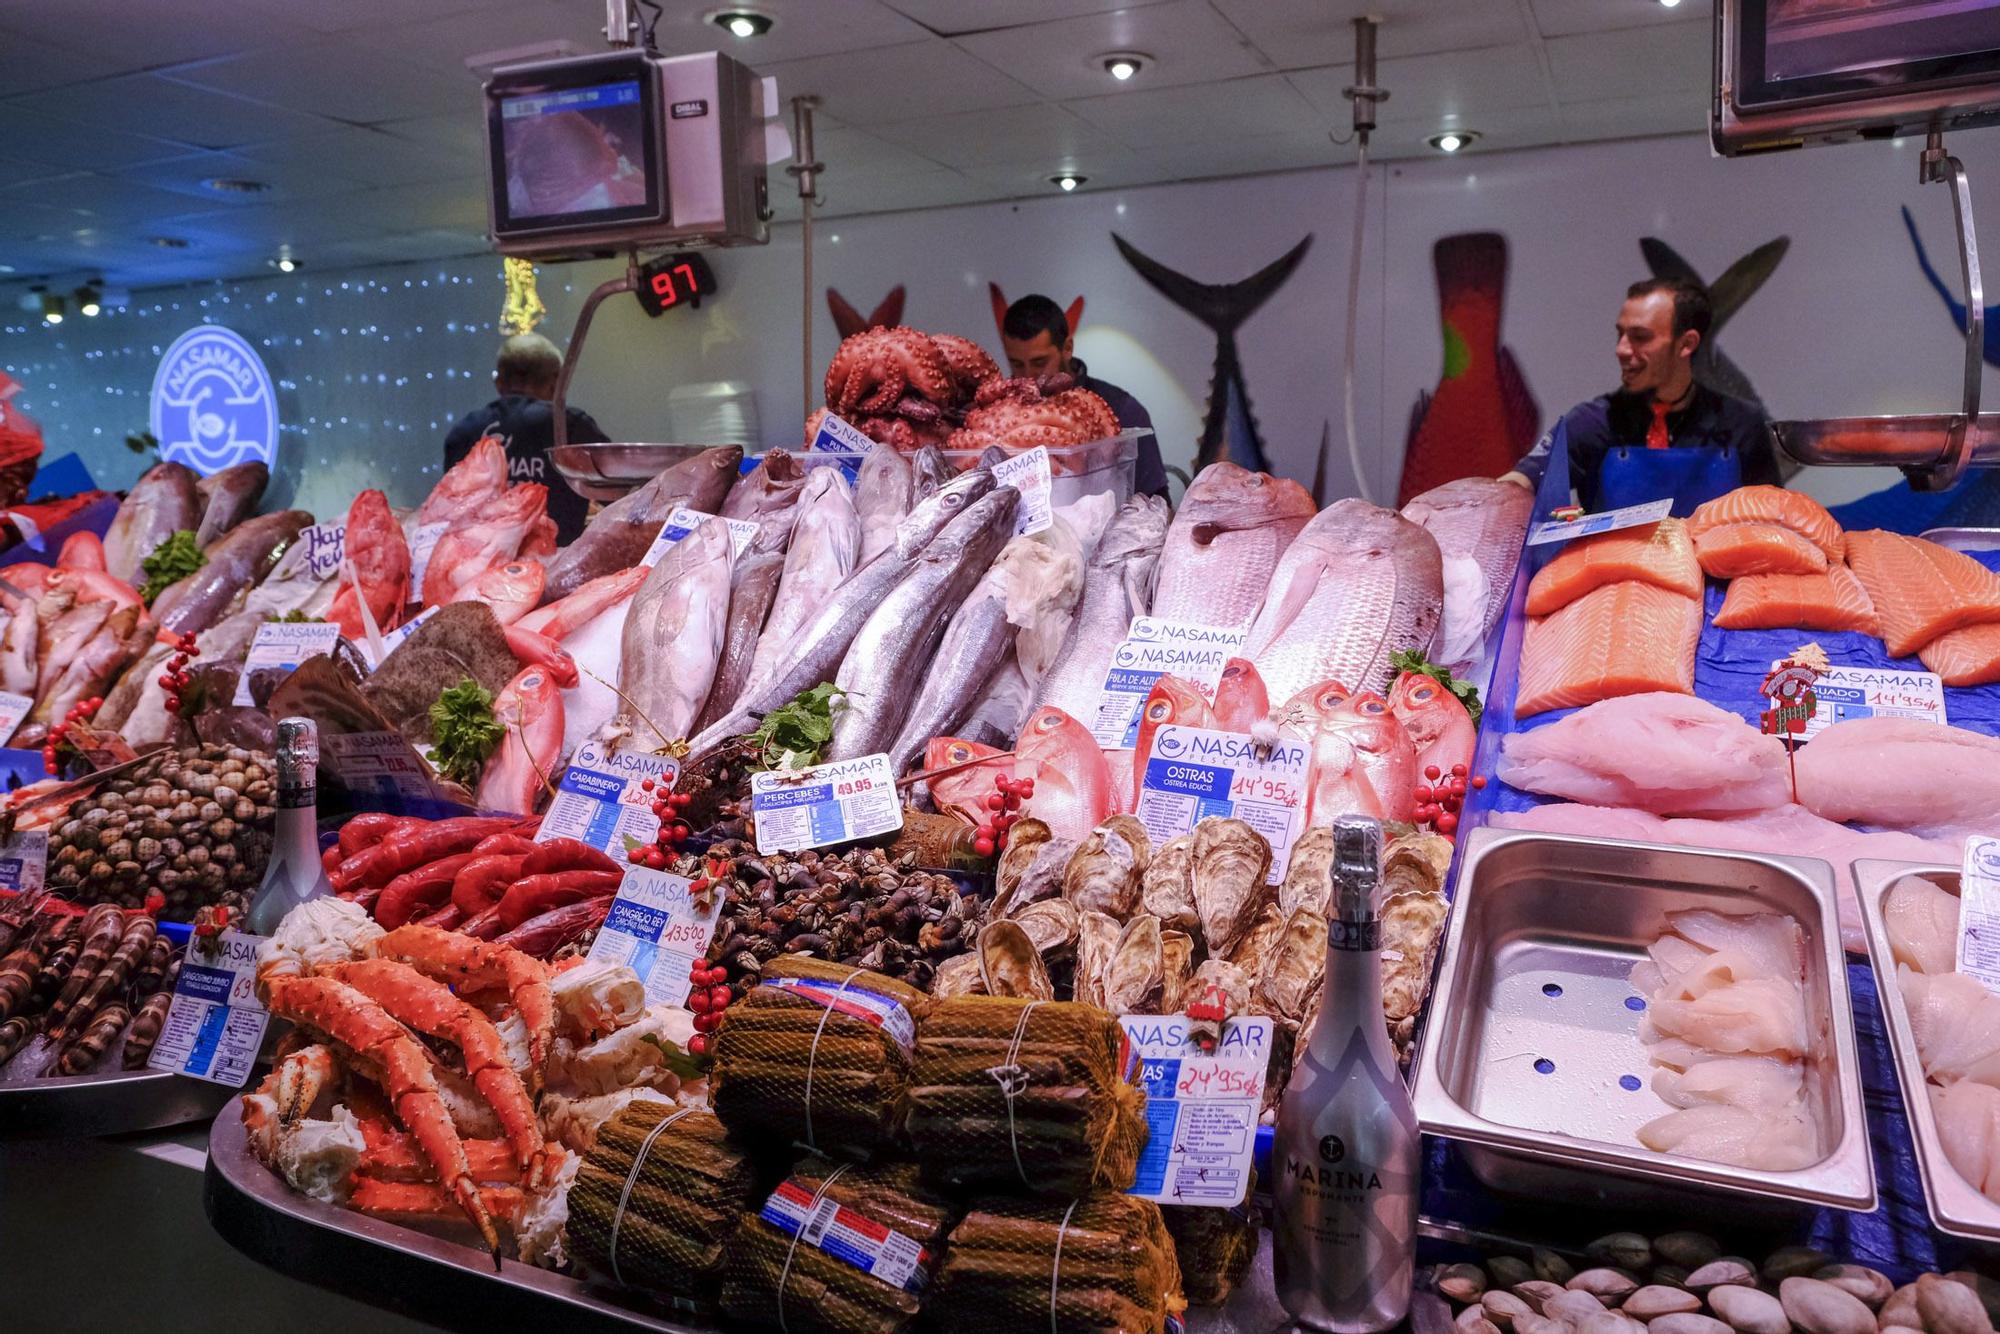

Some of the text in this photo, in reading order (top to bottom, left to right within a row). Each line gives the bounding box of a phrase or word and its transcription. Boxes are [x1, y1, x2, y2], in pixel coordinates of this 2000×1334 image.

[651, 263, 697, 307] 97
[168, 346, 253, 394] NASAMAR
[1140, 648, 1224, 666] NASAMAR
[1191, 736, 1304, 767] NASAMAR
[570, 772, 620, 792] CARABINERO
[1163, 778, 1187, 788] OSTREA
[1167, 766, 1215, 783] OSTRAS
[764, 788, 820, 802] PERCEBES
[614, 905, 666, 928] CANGREJO REY
[1287, 1158, 1382, 1190] MARINA
